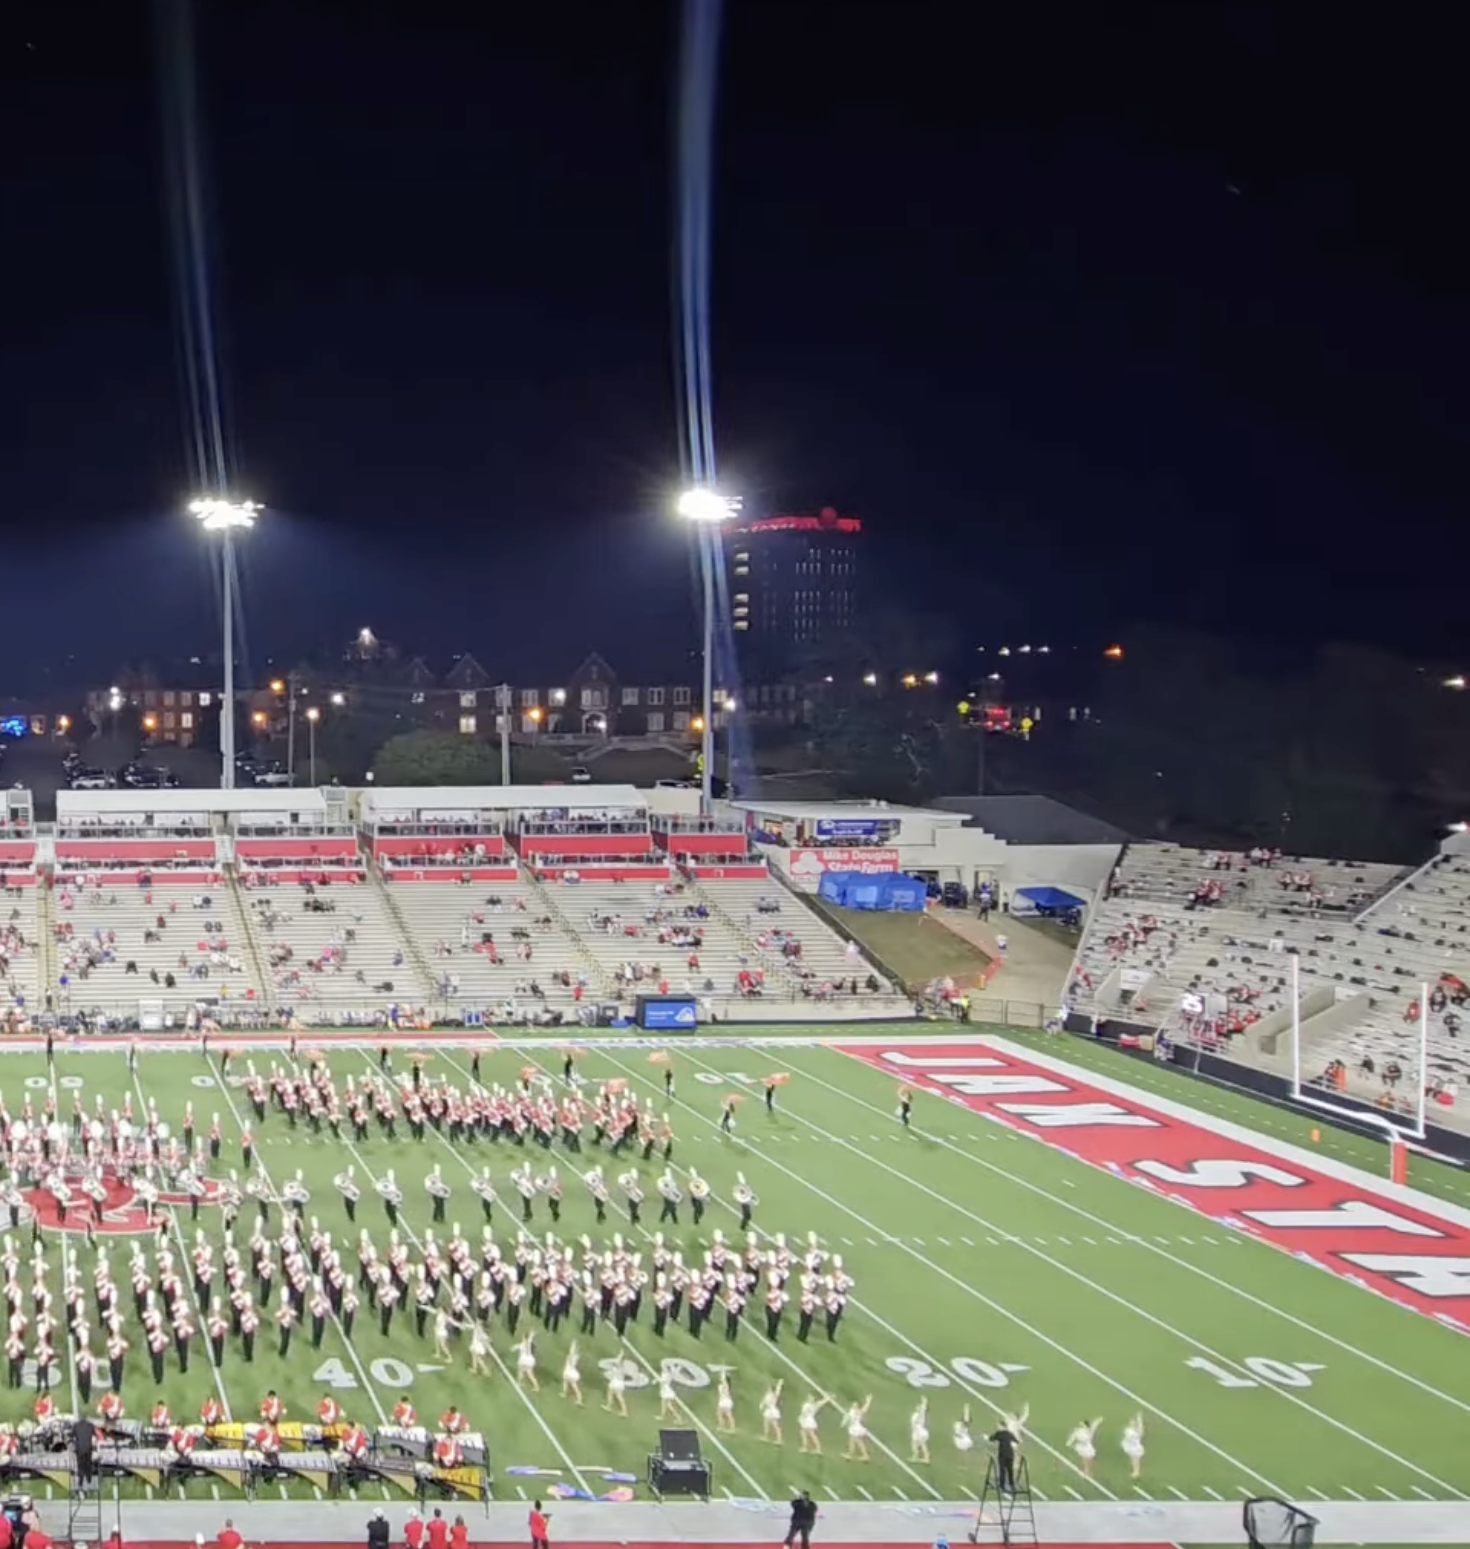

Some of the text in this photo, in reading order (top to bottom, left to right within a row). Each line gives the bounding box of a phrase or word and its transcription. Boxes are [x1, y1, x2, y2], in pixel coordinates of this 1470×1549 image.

[852, 850, 897, 862] Douglas
[312, 1357, 415, 1388] 40
[885, 1356, 1010, 1388] 20
[1183, 1356, 1313, 1388] 10
